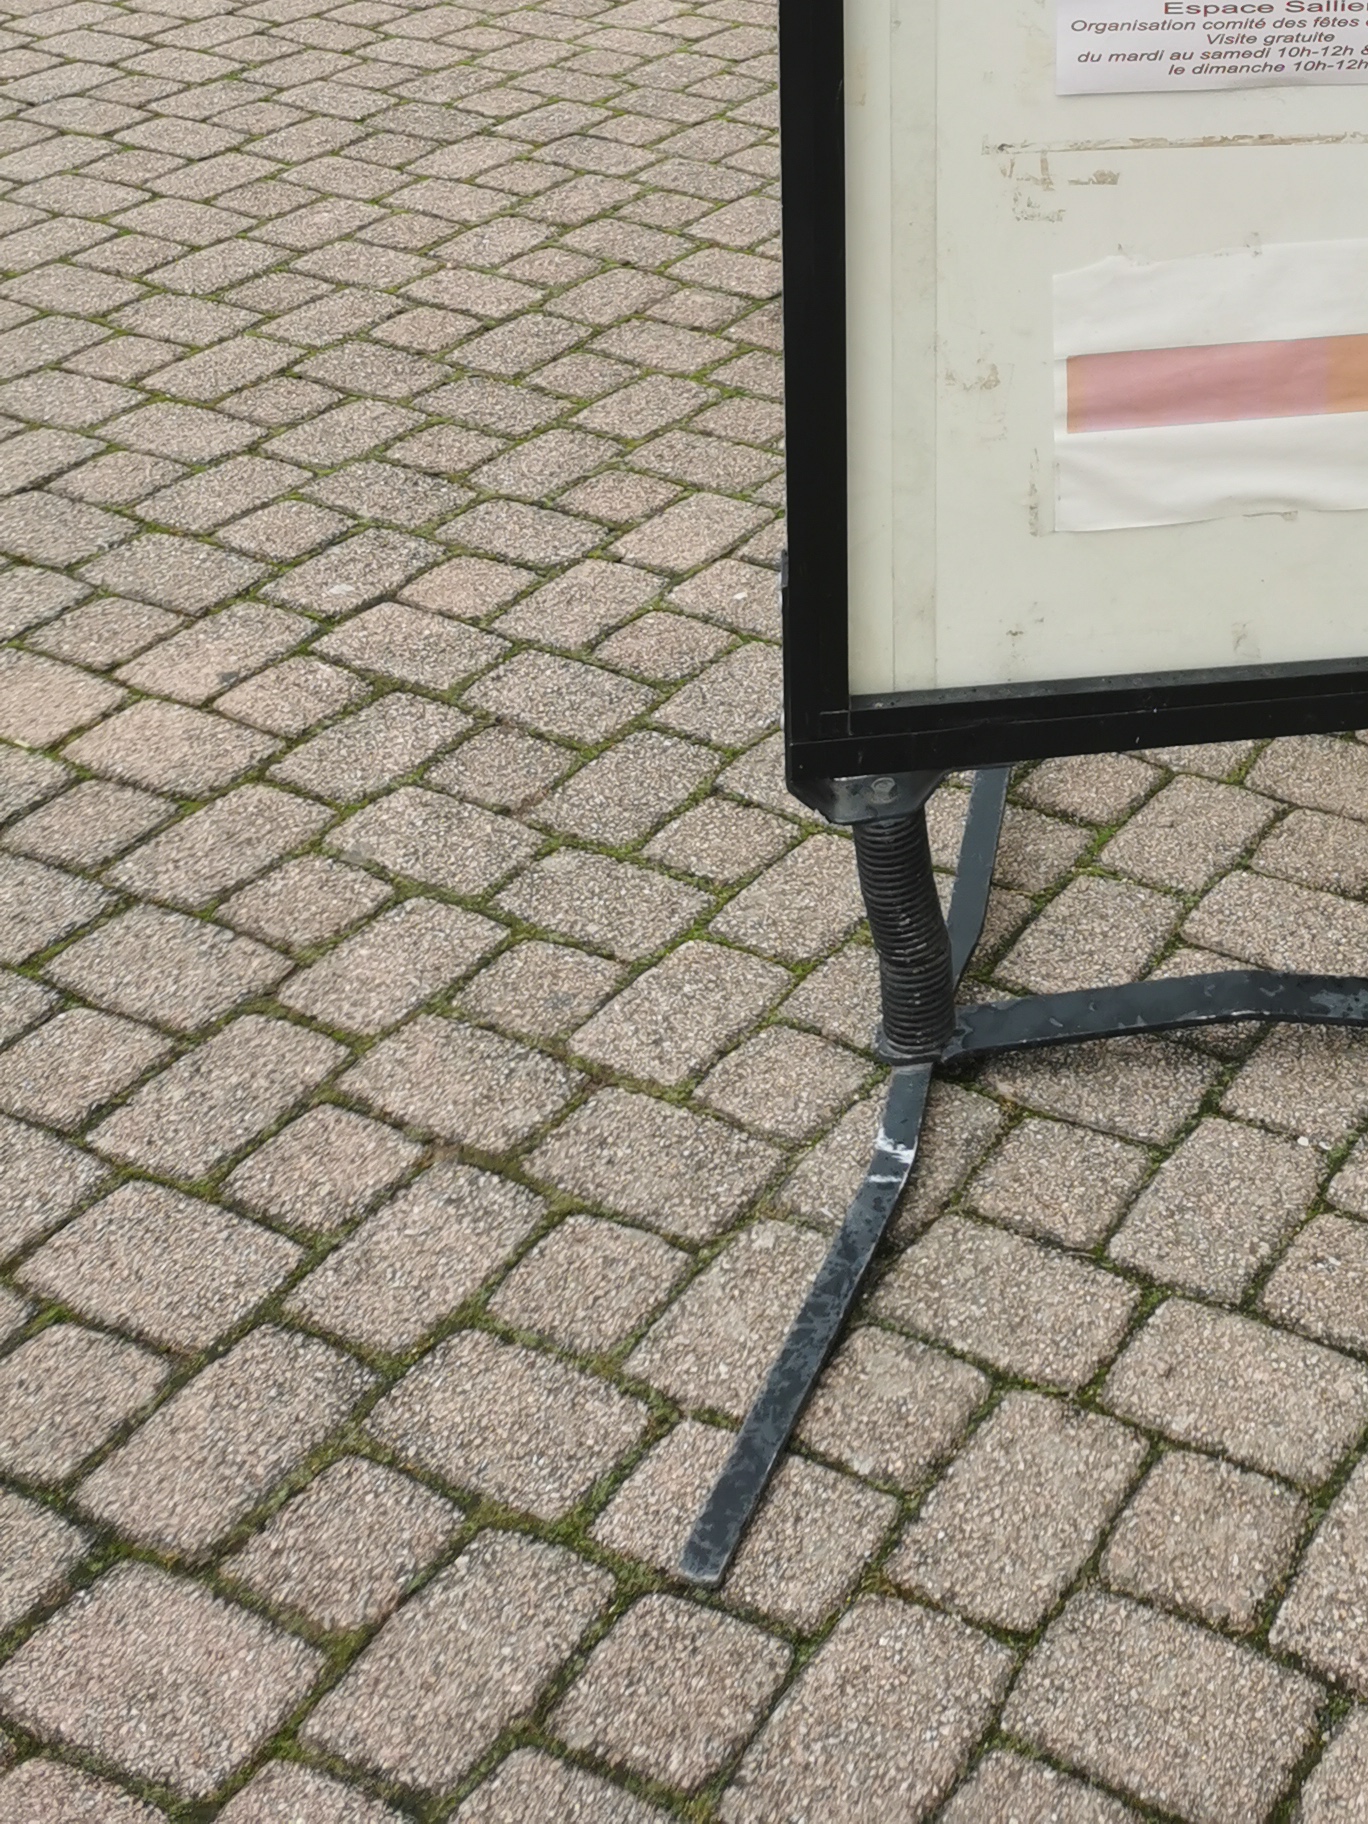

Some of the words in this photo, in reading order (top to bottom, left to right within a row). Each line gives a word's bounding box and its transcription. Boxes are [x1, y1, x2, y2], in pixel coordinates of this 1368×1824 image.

[1164, 2, 1274, 17] Espace
[1070, 19, 1195, 34] Organisation
[1202, 18, 1266, 31] comité
[1272, 17, 1307, 28] des
[1313, 16, 1359, 28] fêtes
[1206, 33, 1257, 45] Visite
[1263, 32, 1335, 46] gratuite
[1077, 51, 1102, 63] du
[1108, 50, 1164, 62] mardi
[1169, 51, 1194, 61] au
[1200, 47, 1271, 60] samedi
[1278, 45, 1354, 58] 10h-12h
[1168, 64, 1185, 75] le
[1191, 61, 1285, 75] dimanche
[1293, 59, 1368, 71] 10h-12h
